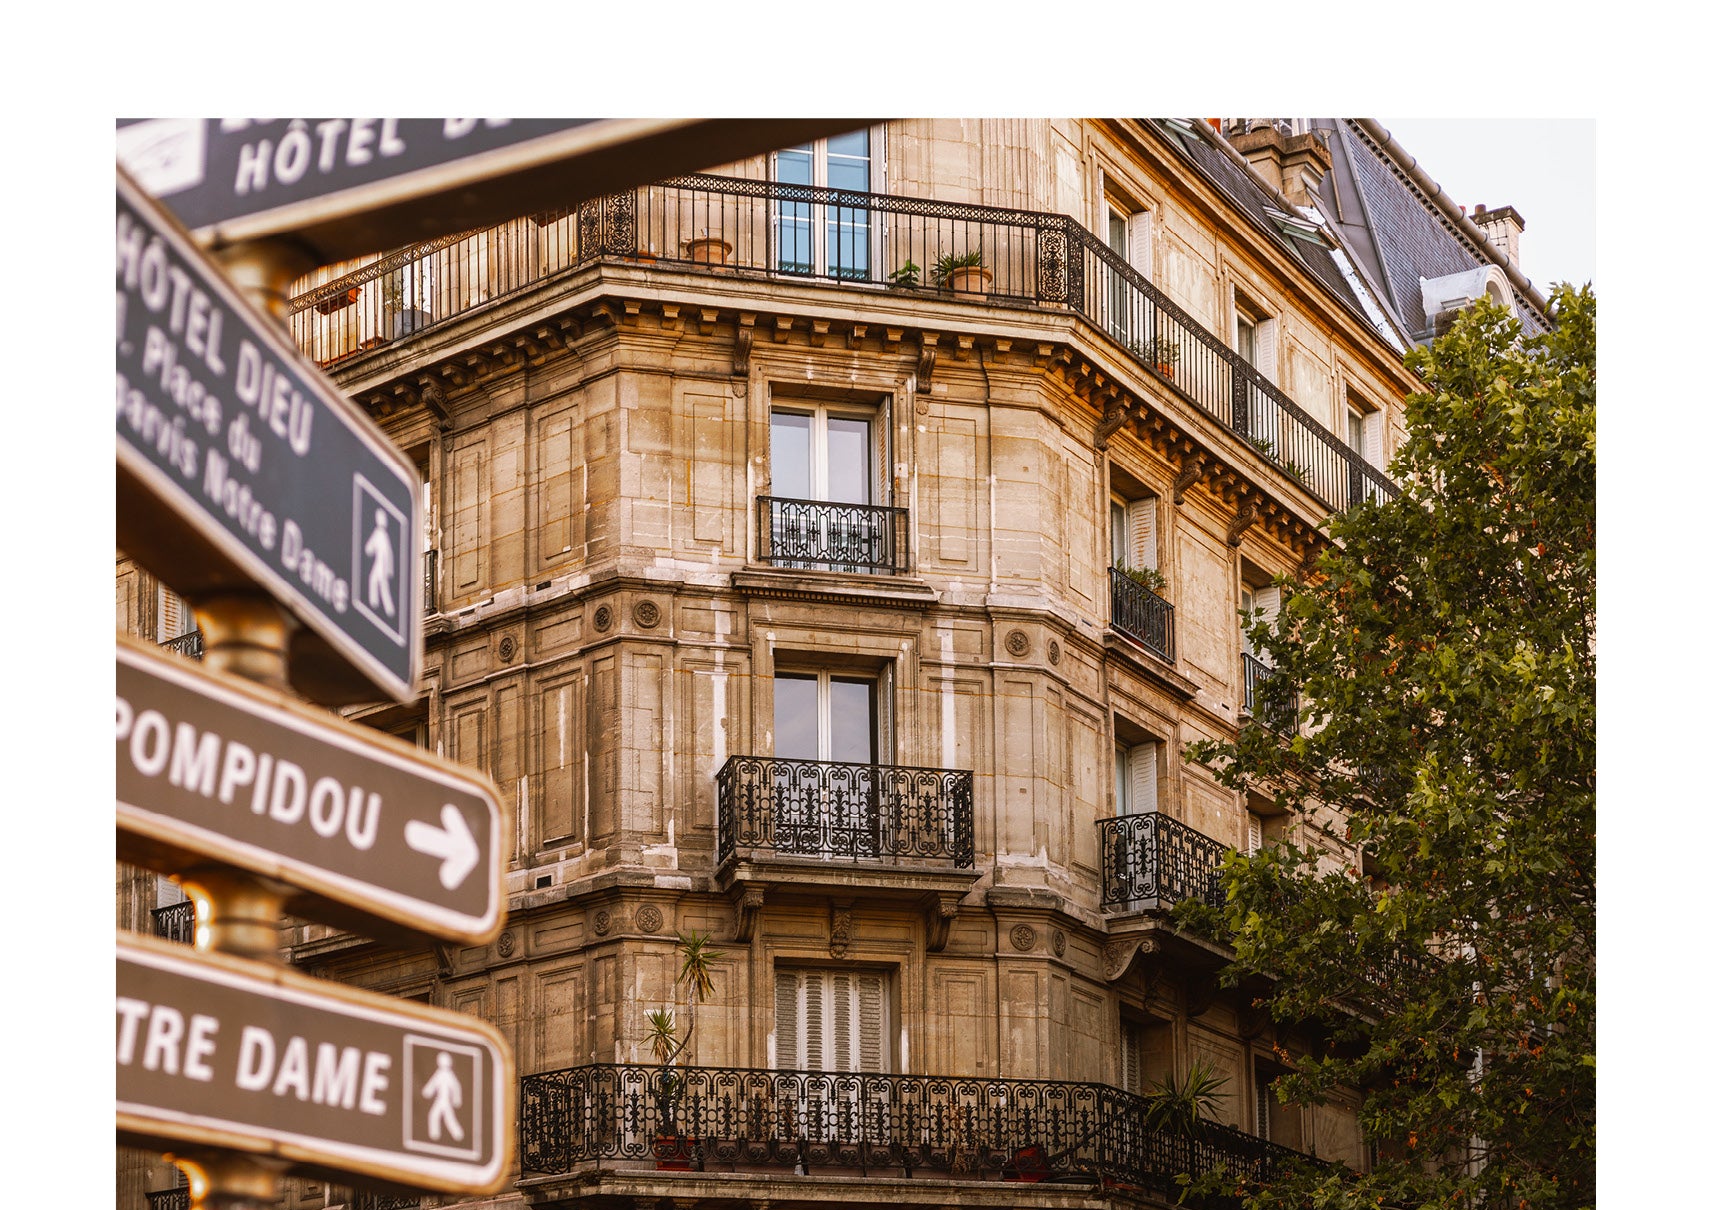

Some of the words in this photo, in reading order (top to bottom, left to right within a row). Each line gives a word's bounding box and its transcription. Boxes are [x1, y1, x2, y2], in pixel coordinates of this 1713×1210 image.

[234, 118, 406, 196] HÔTEL
[116, 211, 226, 376] HÔTEL
[235, 338, 314, 457] DIEU
[142, 324, 223, 436] Place
[227, 411, 262, 475] du
[203, 447, 277, 550] Notre
[281, 517, 350, 615] Dame
[235, 1024, 393, 1117] DAME
